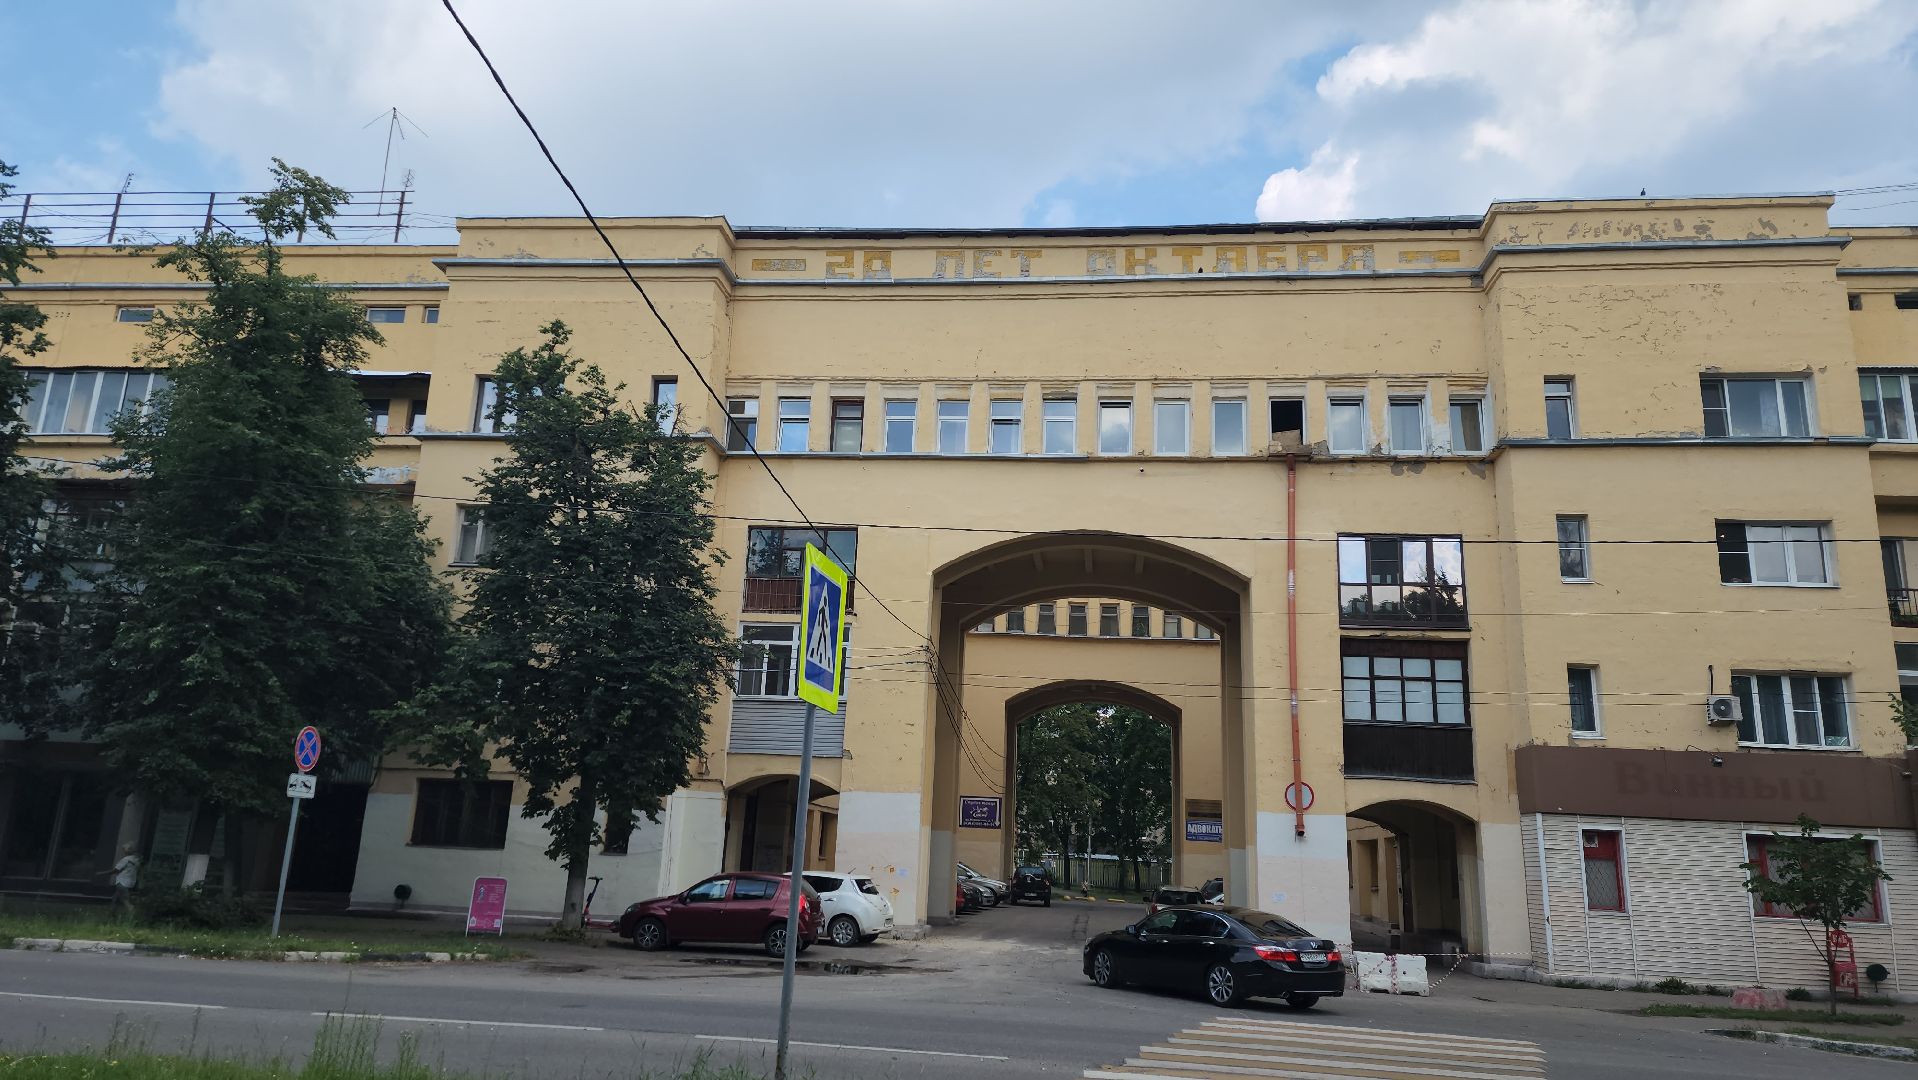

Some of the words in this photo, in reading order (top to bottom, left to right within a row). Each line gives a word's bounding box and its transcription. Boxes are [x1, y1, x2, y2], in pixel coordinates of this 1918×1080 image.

[826, 251, 892, 279] 20
[932, 250, 1042, 279] ЛЕТ
[1086, 245, 1375, 276] ОКТЯБРЯ
[1614, 760, 1827, 803] Винный
